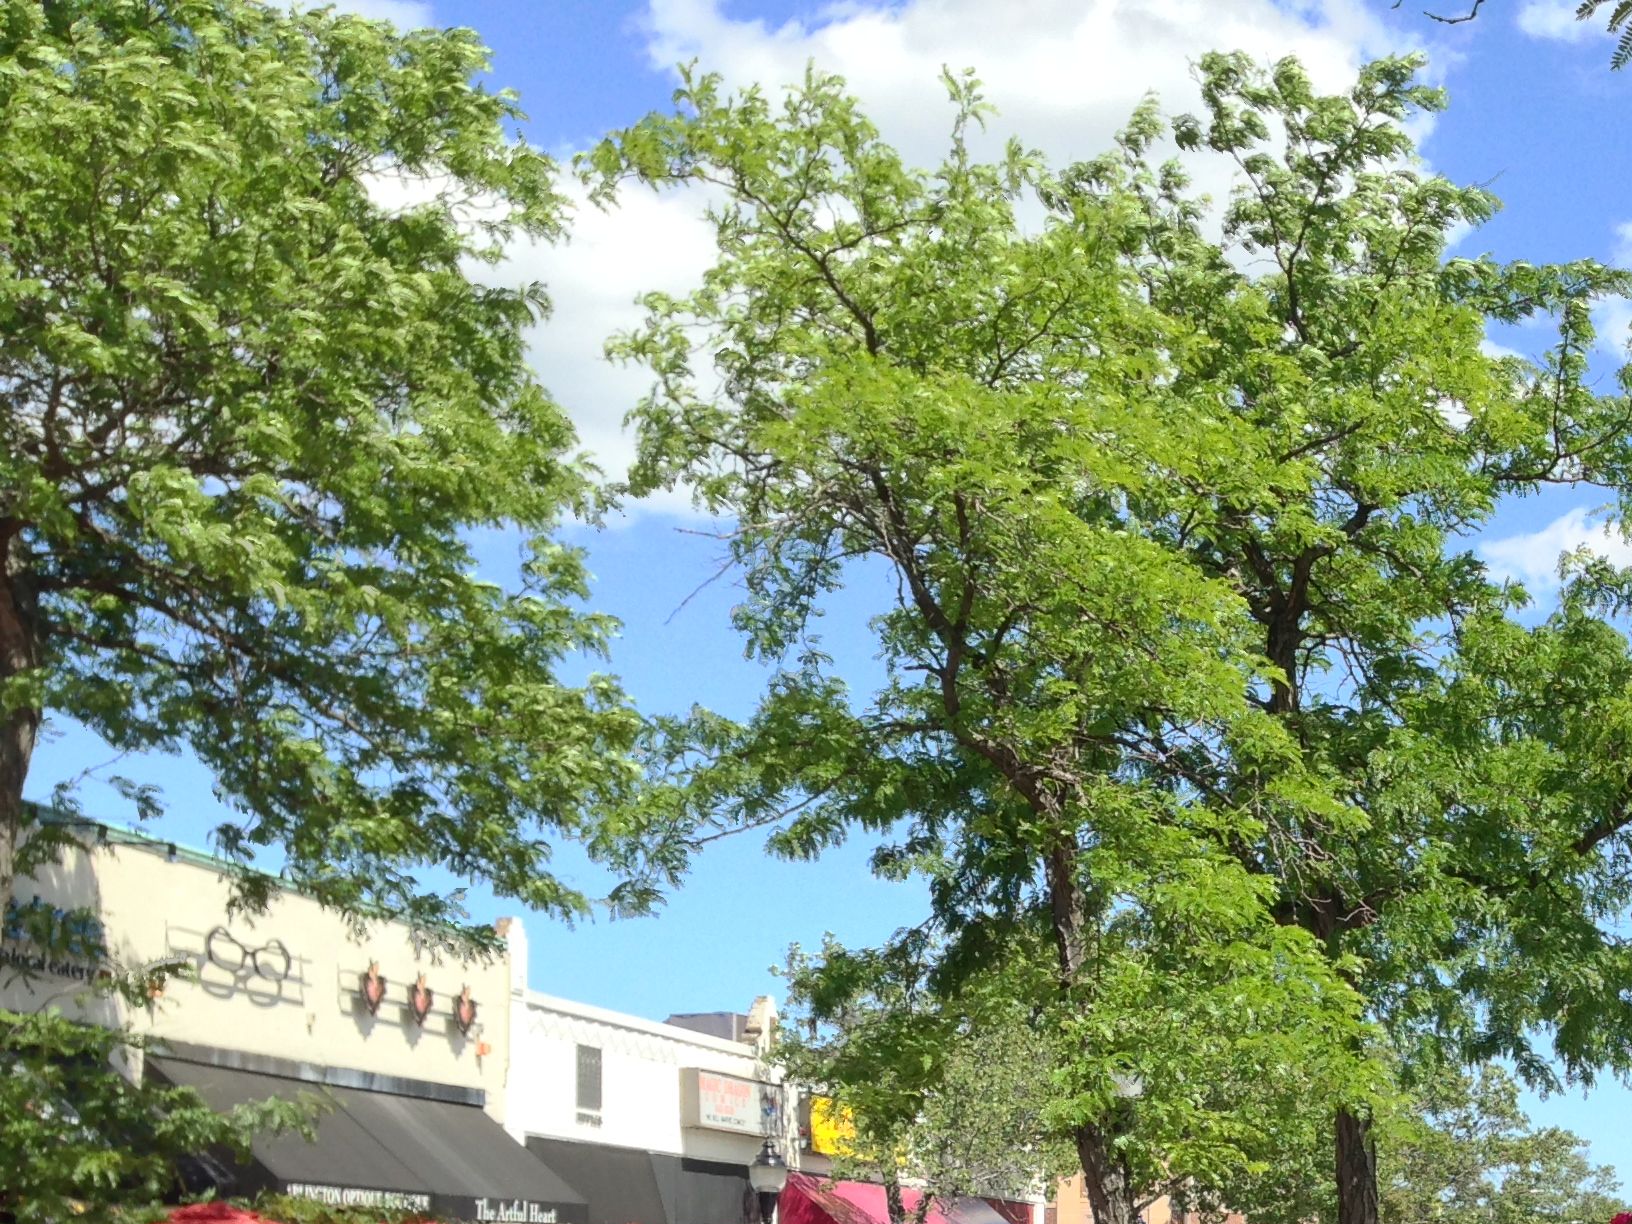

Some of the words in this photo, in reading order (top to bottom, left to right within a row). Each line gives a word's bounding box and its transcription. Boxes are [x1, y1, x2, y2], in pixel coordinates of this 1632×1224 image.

[475, 1198, 496, 1221] The
[497, 1199, 528, 1222] Artful
[529, 1203, 557, 1224] Heart
